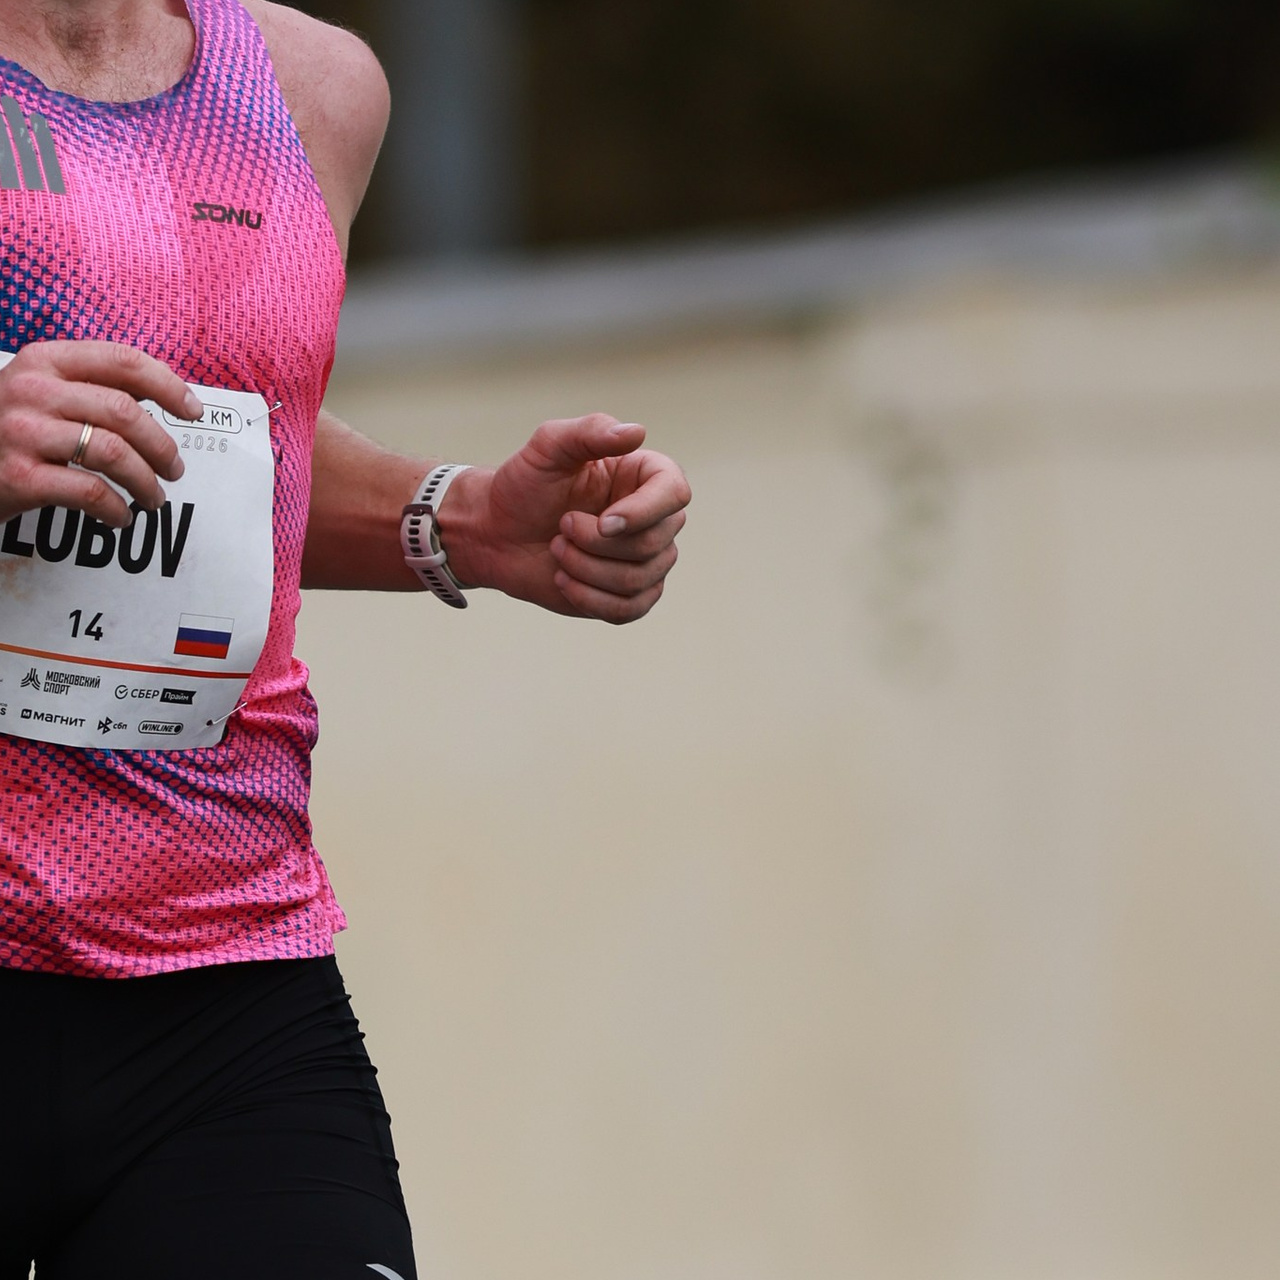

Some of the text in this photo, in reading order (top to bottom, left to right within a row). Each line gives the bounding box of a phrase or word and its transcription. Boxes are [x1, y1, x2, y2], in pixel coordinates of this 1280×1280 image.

[192, 203, 262, 229] SONU
[181, 434, 228, 453] 2026
[1, 501, 195, 578] LOBOV
[69, 609, 103, 641] 14
[43, 681, 71, 696] СПОРТ
[45, 670, 101, 689] МОСКОВСКИЙ
[130, 688, 190, 701] СБЕР Прайм
[141, 723, 175, 733] WINLINE
